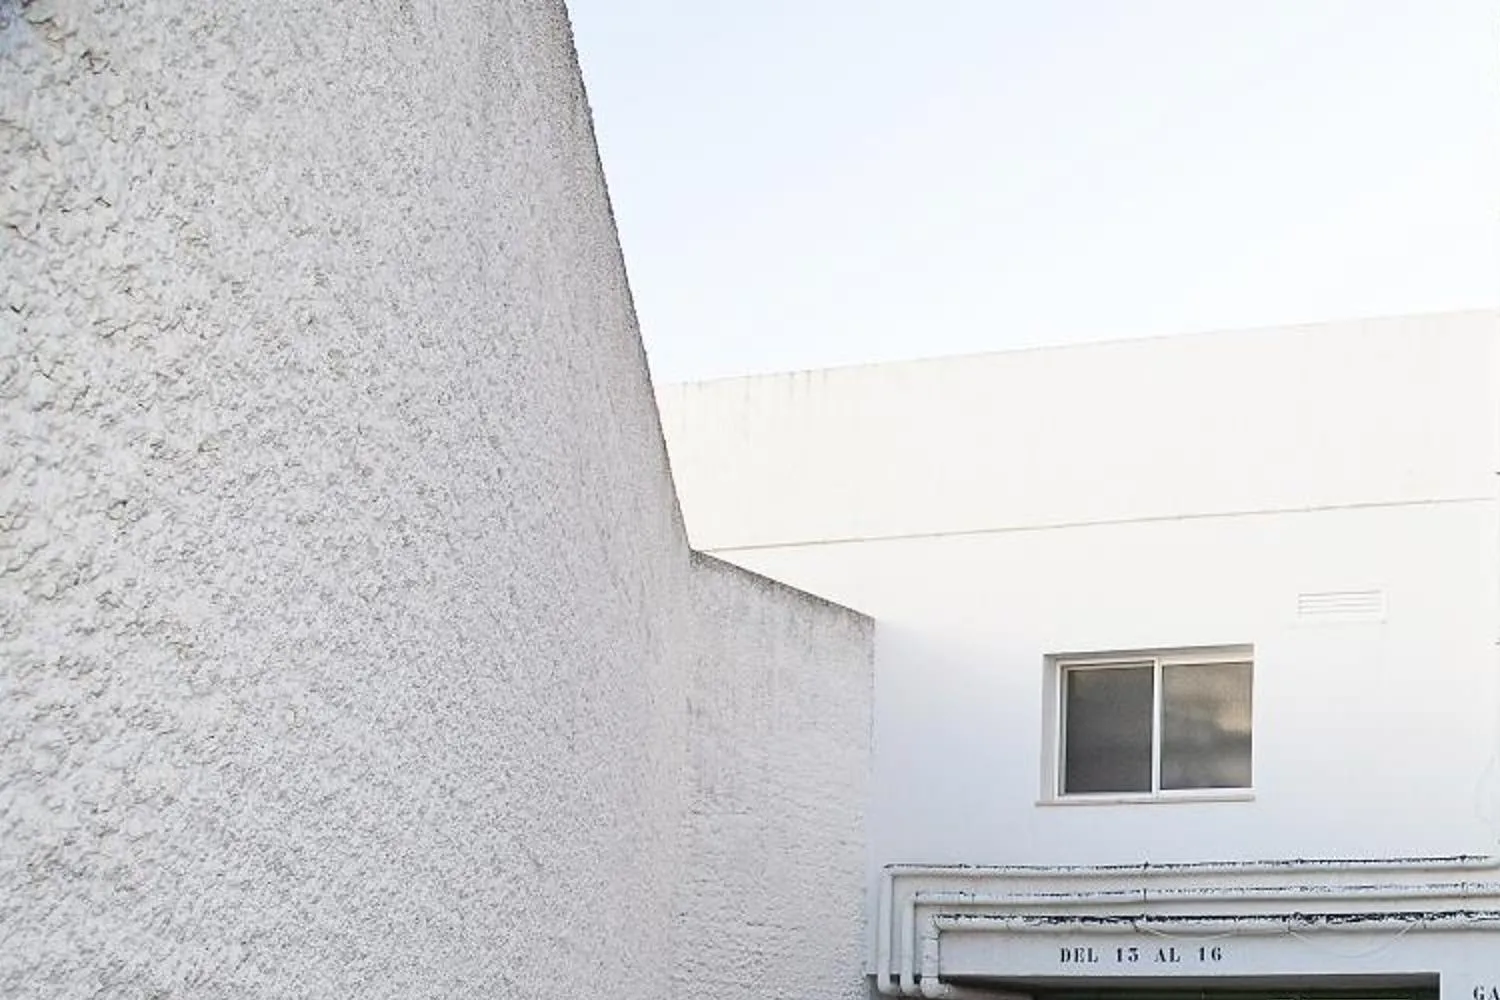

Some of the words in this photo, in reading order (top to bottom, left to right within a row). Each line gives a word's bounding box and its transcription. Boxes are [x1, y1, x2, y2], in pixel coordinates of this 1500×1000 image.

[1060, 947, 1099, 963] DEL
[1154, 947, 1181, 963] AL
[1199, 946, 1222, 961] 16
